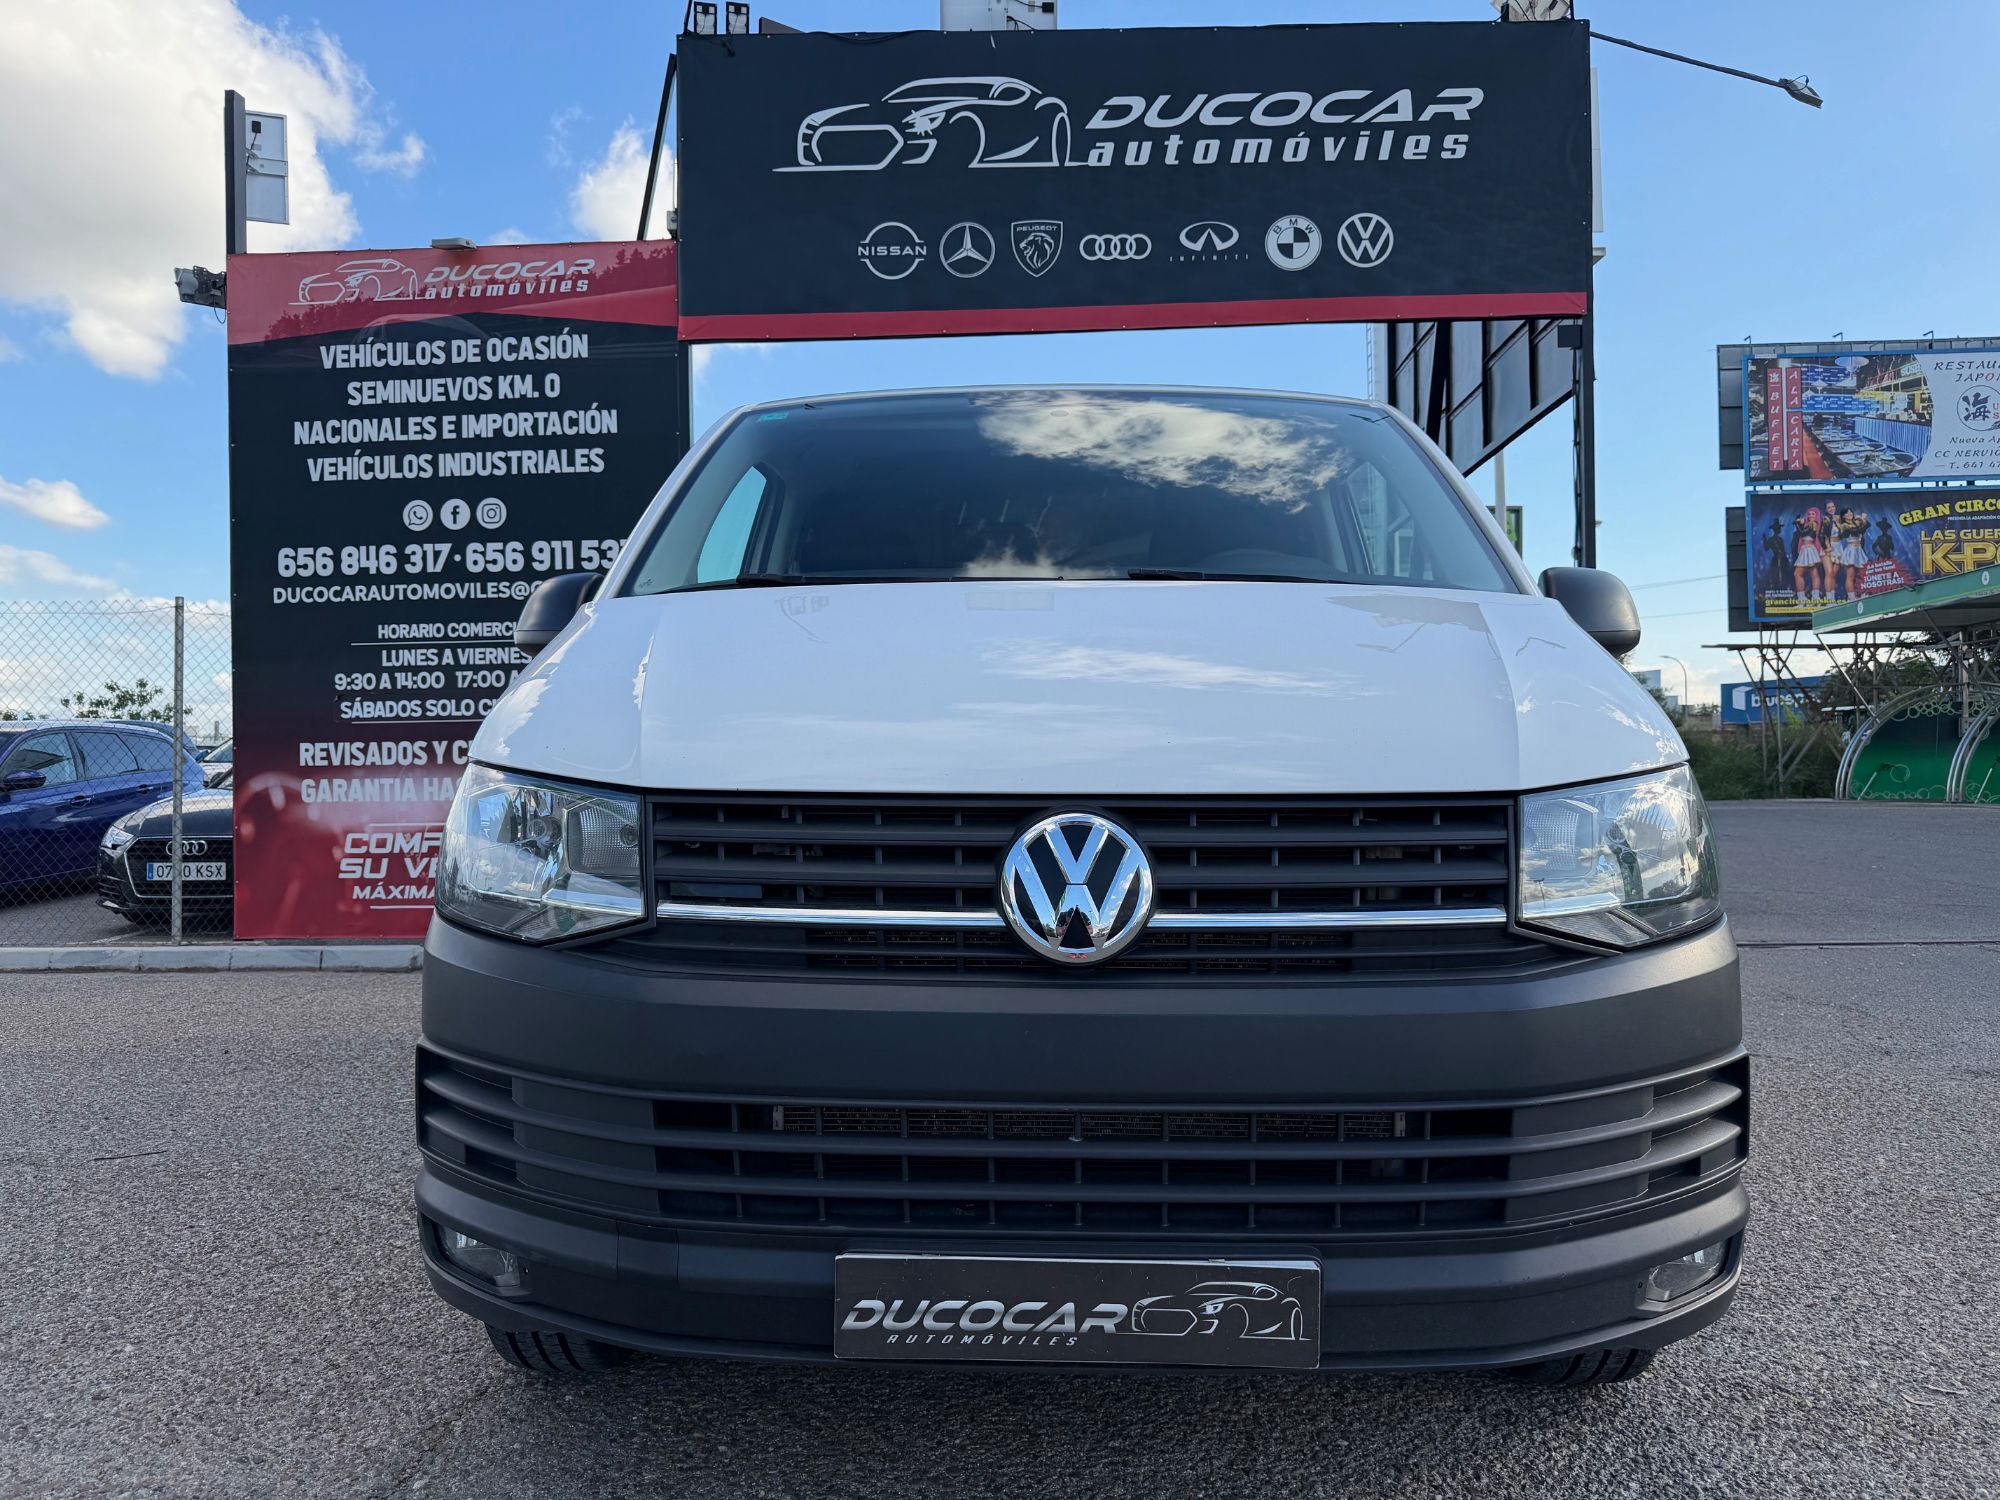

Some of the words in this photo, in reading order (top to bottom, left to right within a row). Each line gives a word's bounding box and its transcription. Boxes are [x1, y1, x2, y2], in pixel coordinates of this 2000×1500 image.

[1084, 87, 1485, 129] DUCOCAR
[1087, 129, 1471, 167] automóviles
[1271, 218, 1316, 236] BMW
[858, 245, 927, 256] NISSAN
[423, 258, 596, 283] DUCOCAR
[424, 276, 589, 300] automóviles
[320, 338, 446, 370] VEHÍCULOS
[450, 339, 481, 364] DE
[486, 327, 589, 362] OCASIÓN
[1934, 361, 2000, 371] RESTAU
[1955, 372, 2000, 383] JAPO
[347, 375, 493, 406] SEMINUEVOS
[498, 375, 540, 399] KM.
[294, 416, 437, 445] NACIONALES
[442, 416, 457, 439] E
[461, 402, 618, 439] IMPORTACIÓN
[307, 449, 434, 482] VEHÍCULOS
[438, 447, 605, 478] INDUSTRIALES
[1898, 503, 1951, 526] GRAN
[1954, 498, 2000, 513] CIRC
[1920, 529, 1956, 541] LAS
[277, 546, 334, 578] 656
[340, 544, 398, 576] 846
[531, 540, 574, 571] 911
[580, 538, 628, 570] 53
[377, 623, 445, 640] HORARIO
[382, 648, 439, 667] LUNES
[441, 648, 455, 666] A
[334, 672, 377, 691] 9:30
[379, 672, 393, 690] A
[394, 671, 445, 690] 14:00
[455, 670, 506, 689] 17:00
[340, 698, 422, 719] SÁBADOS
[425, 699, 475, 718] SOLO
[299, 740, 428, 767] REVISADOS
[432, 740, 448, 764] Y
[301, 777, 415, 804] GARANTIA
[156, 864, 191, 878] 070
[195, 864, 223, 878] KSX
[338, 857, 389, 879] SU
[840, 1299, 1129, 1334] DUCOCAR
[886, 1332, 1078, 1347] AUTOMÓVILES
